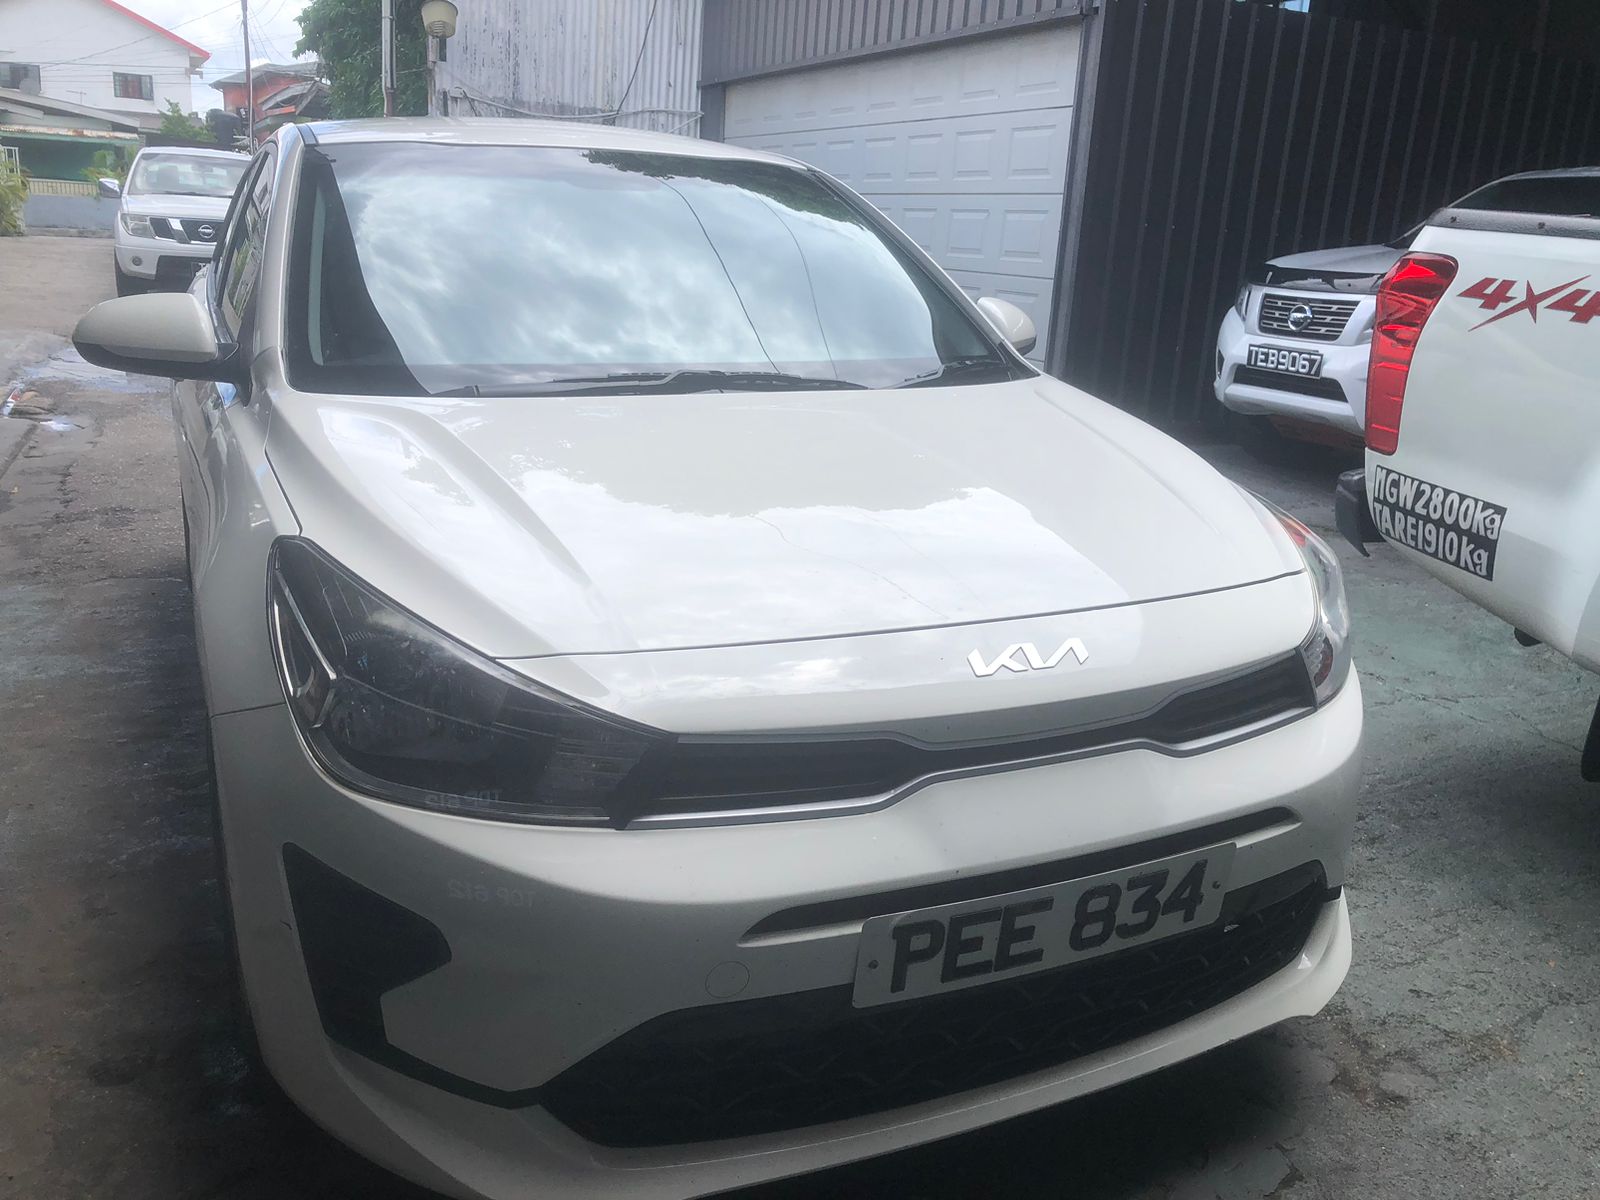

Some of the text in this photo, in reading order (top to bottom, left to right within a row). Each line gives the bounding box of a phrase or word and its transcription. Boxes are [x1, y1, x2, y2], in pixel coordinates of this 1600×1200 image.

[1250, 346, 1321, 375] TEB9067
[967, 637, 1090, 678] KIA
[889, 858, 1209, 993] PEE 834
